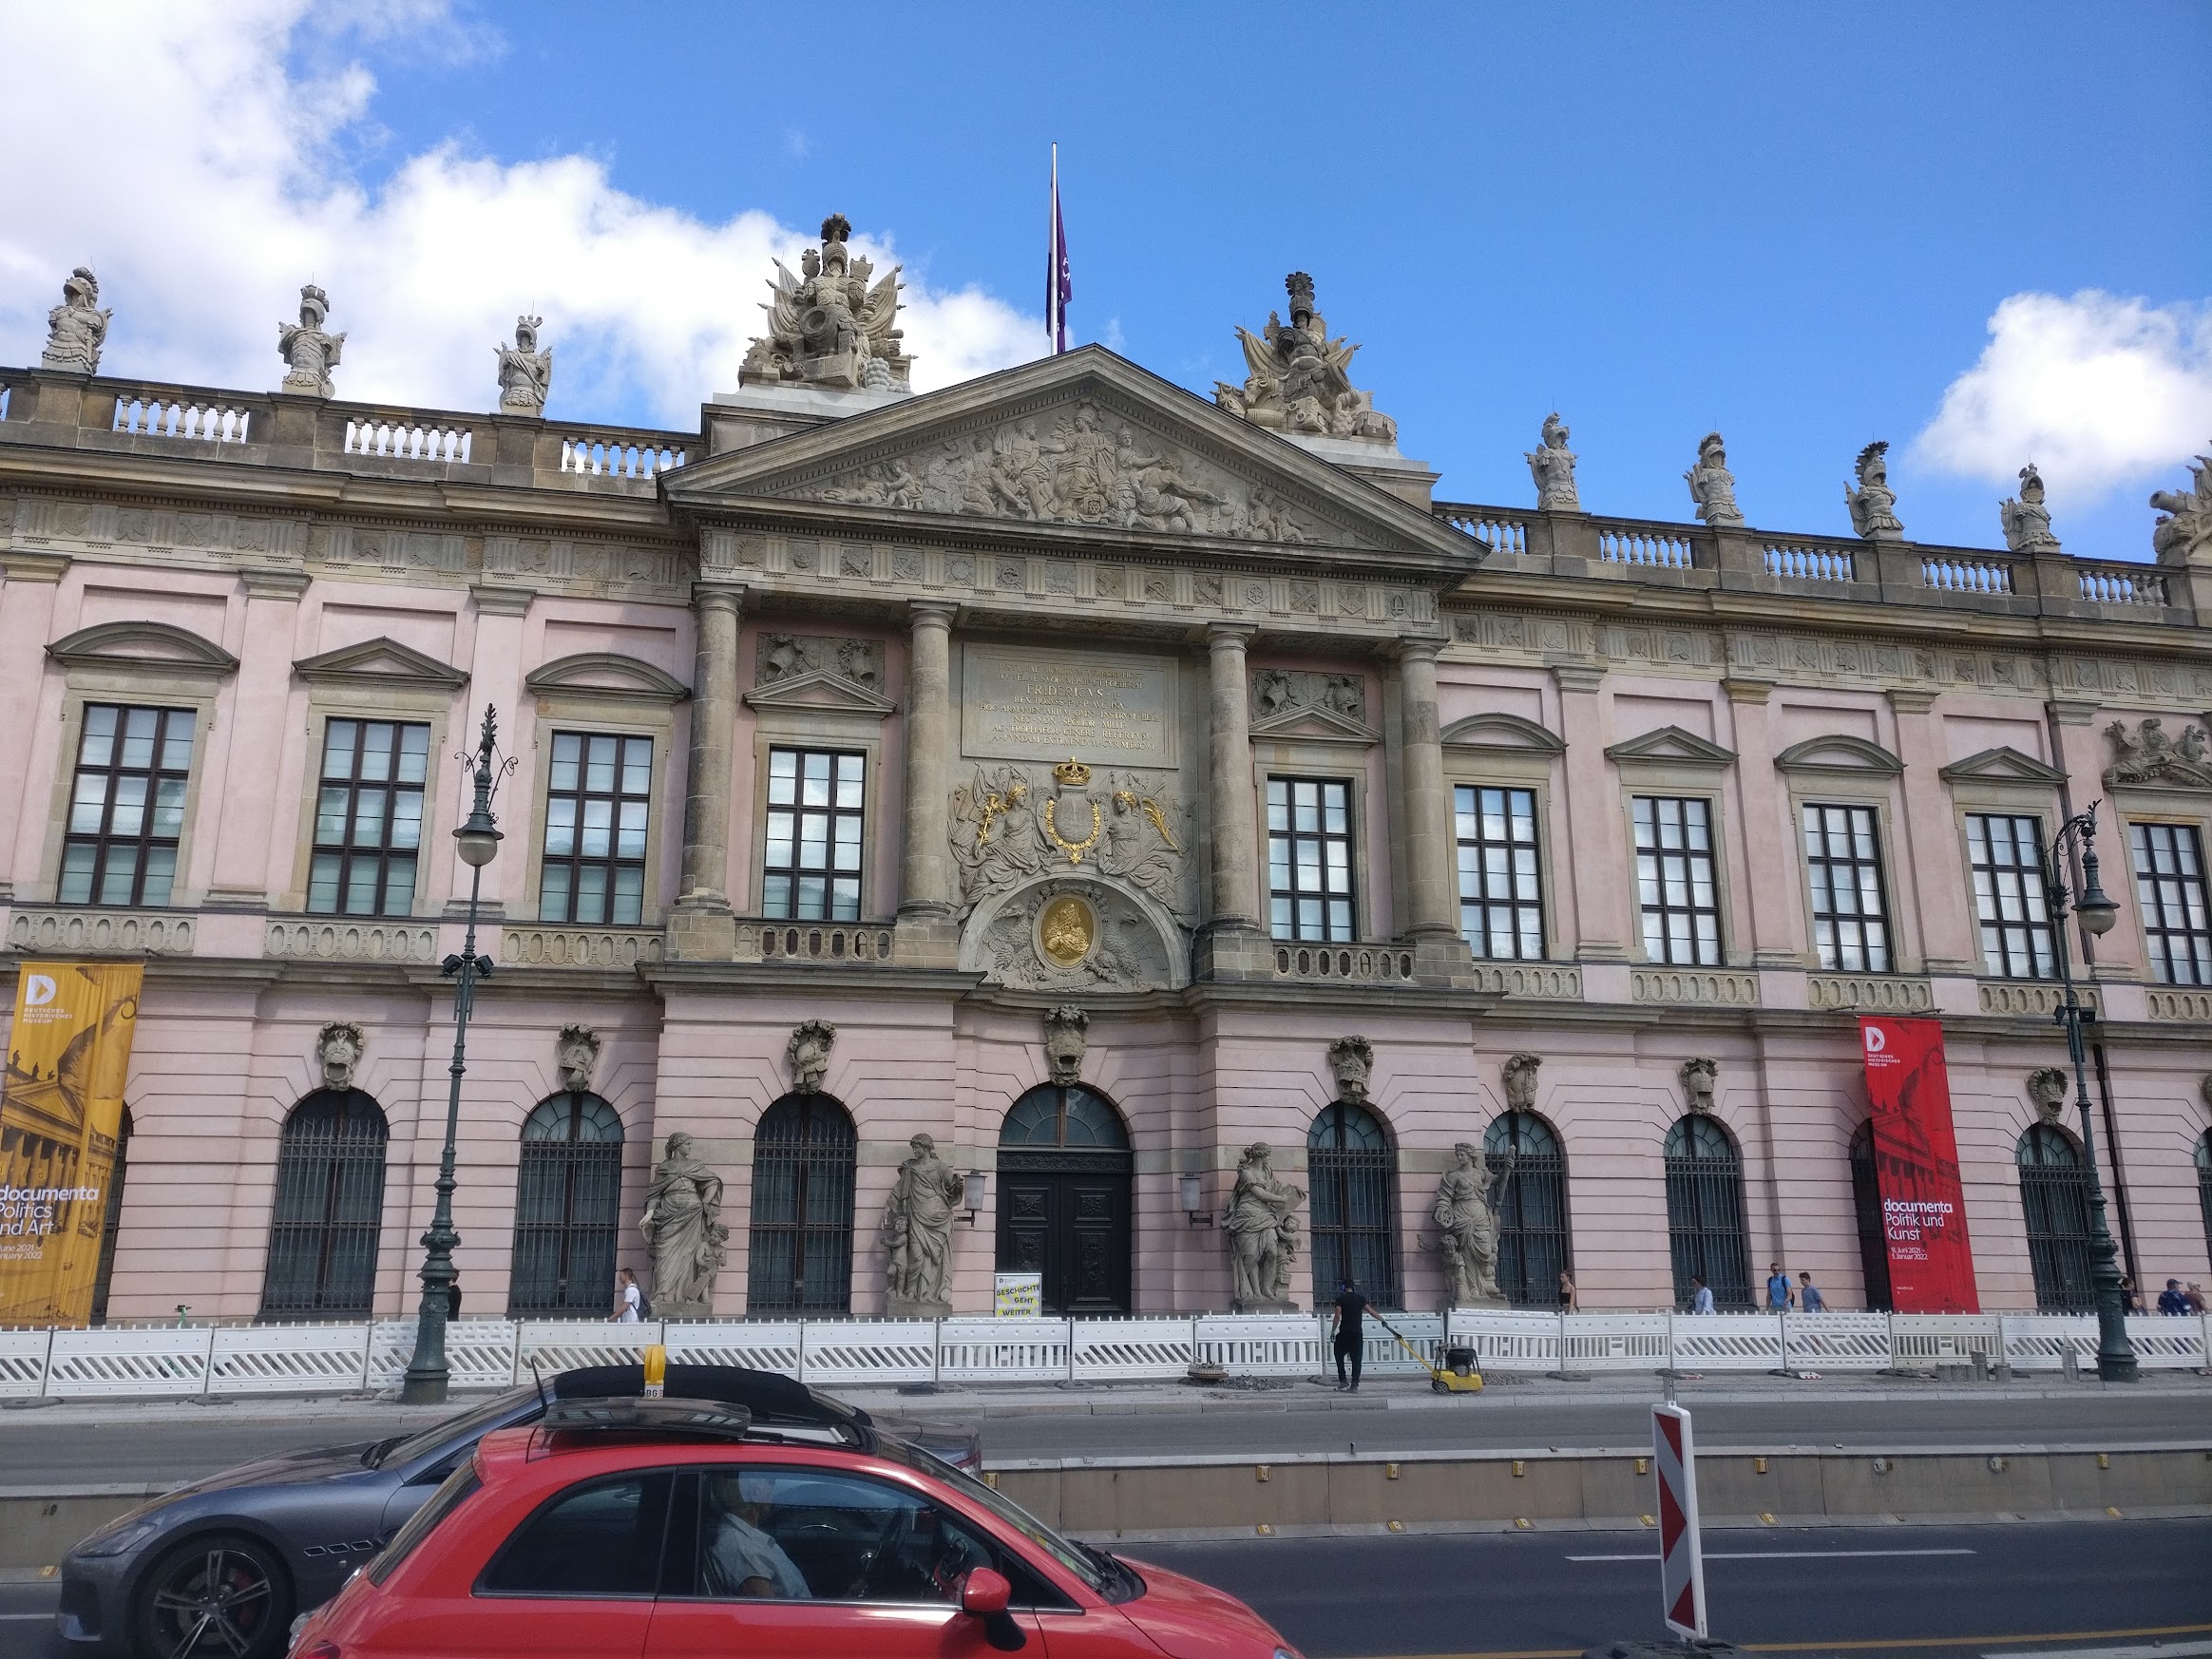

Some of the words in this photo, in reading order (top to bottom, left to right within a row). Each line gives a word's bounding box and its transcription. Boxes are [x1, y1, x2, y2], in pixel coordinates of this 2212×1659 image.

[1027, 684, 1103, 698] FRIDERICVS
[980, 703, 998, 712] HOC
[1037, 716, 1056, 725] NON
[1063, 729, 1096, 737] GENERE
[0, 1184, 99, 1201] documenta
[1883, 1198, 1953, 1213] documenta
[0, 1219, 24, 1235] nd
[25, 1219, 54, 1235] Art
[1886, 1212, 1920, 1226] Politik
[1922, 1213, 1945, 1228] und
[1887, 1227, 1920, 1241] Kunst
[23, 1251, 43, 1260] 2022
[996, 1285, 1040, 1296] GESCHICHTE
